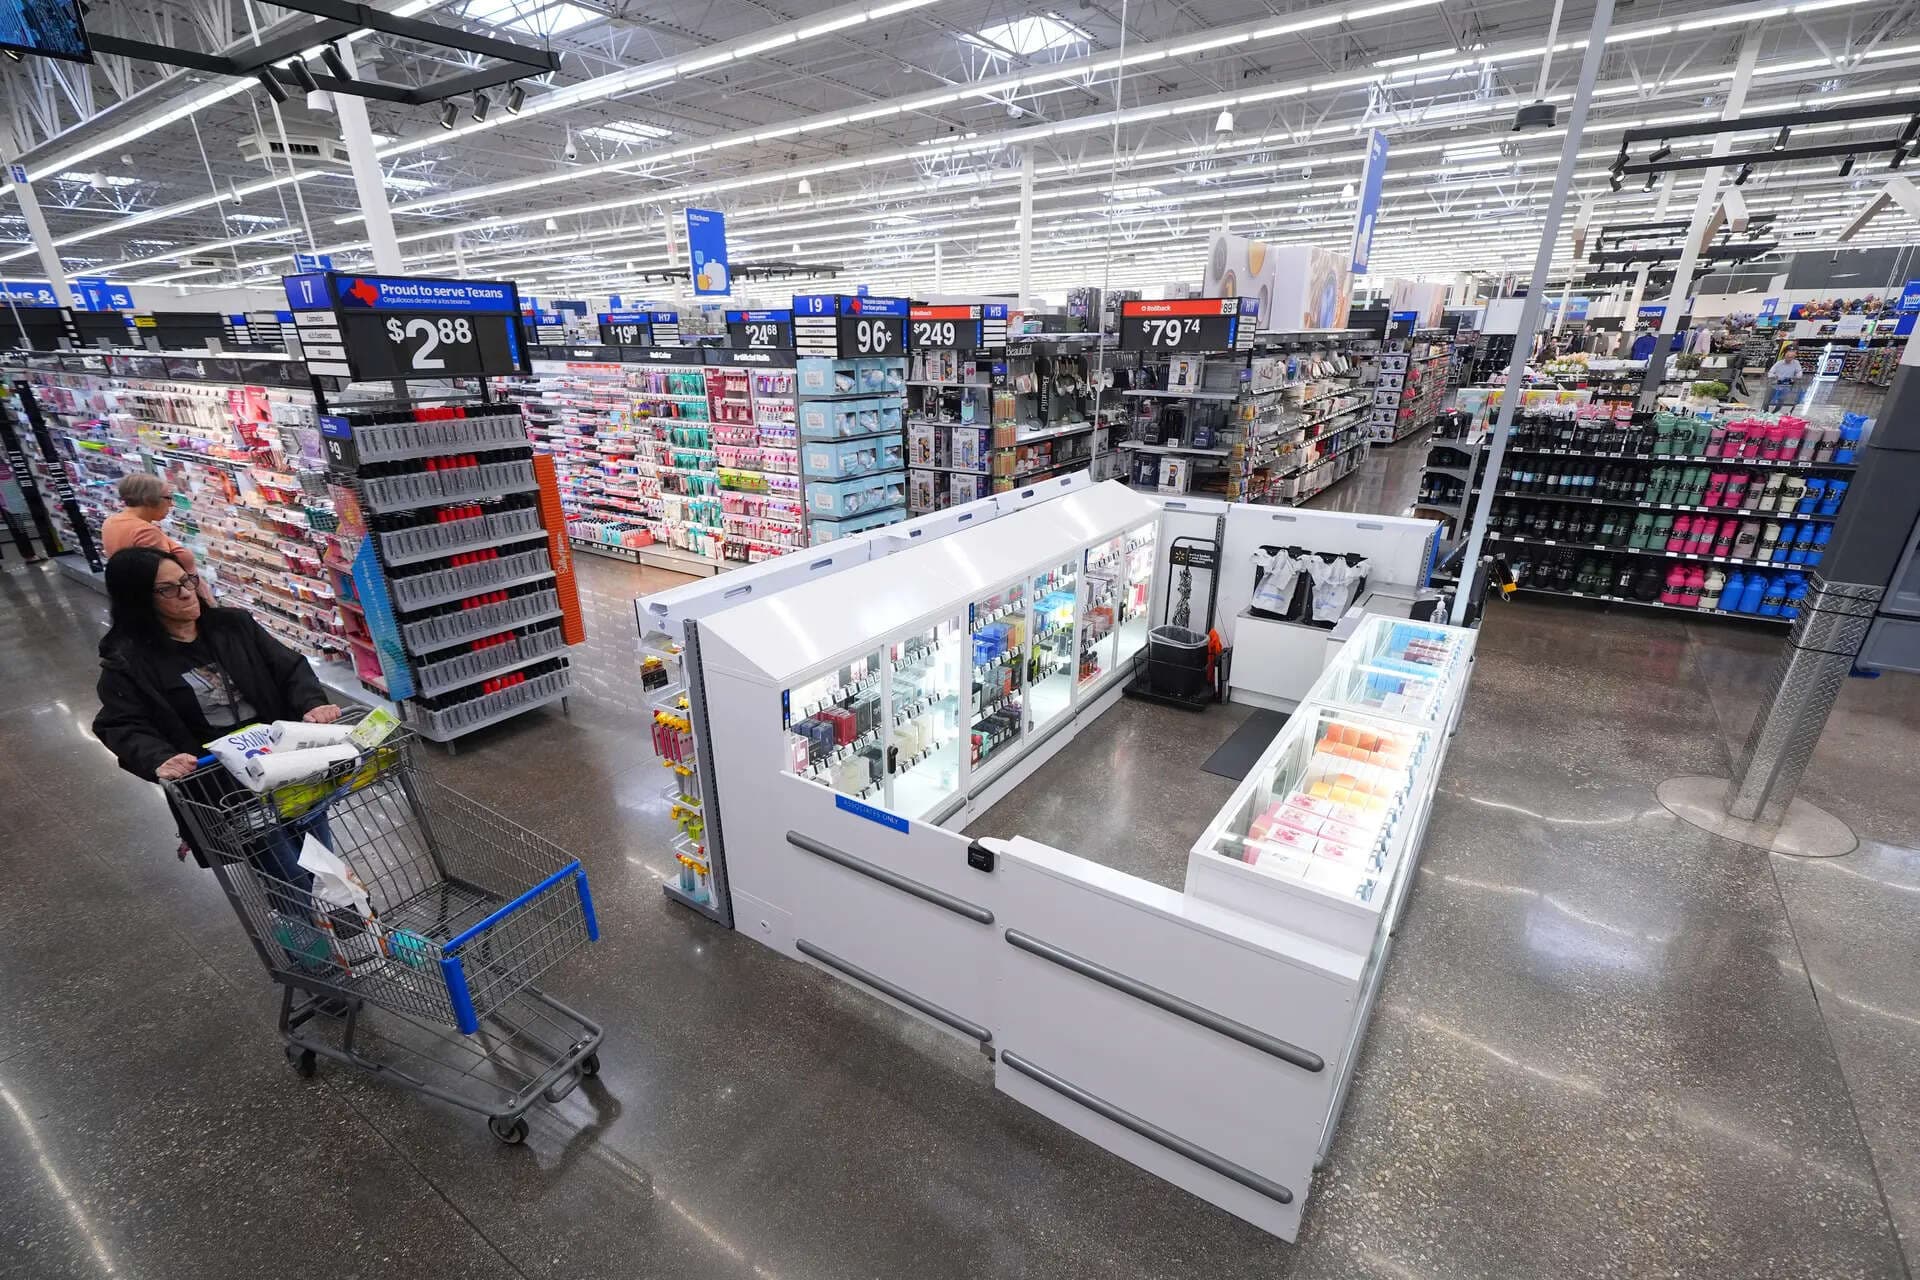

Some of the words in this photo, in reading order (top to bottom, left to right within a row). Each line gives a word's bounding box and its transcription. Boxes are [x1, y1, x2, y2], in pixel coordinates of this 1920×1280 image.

[300, 280, 313, 304] 17
[380, 284, 418, 296] Proud
[419, 285, 433, 296] to
[434, 287, 465, 298] serve
[465, 287, 504, 299] Texans
[808, 298, 823, 313] 19
[1618, 320, 1650, 328] Rbok
[857, 320, 892, 353] 96¢
[913, 322, 955, 346] $249
[1006, 344, 1032, 357] Beautiful
[1041, 375, 1049, 412] Beautiful
[882, 814, 898, 825] ONLY
